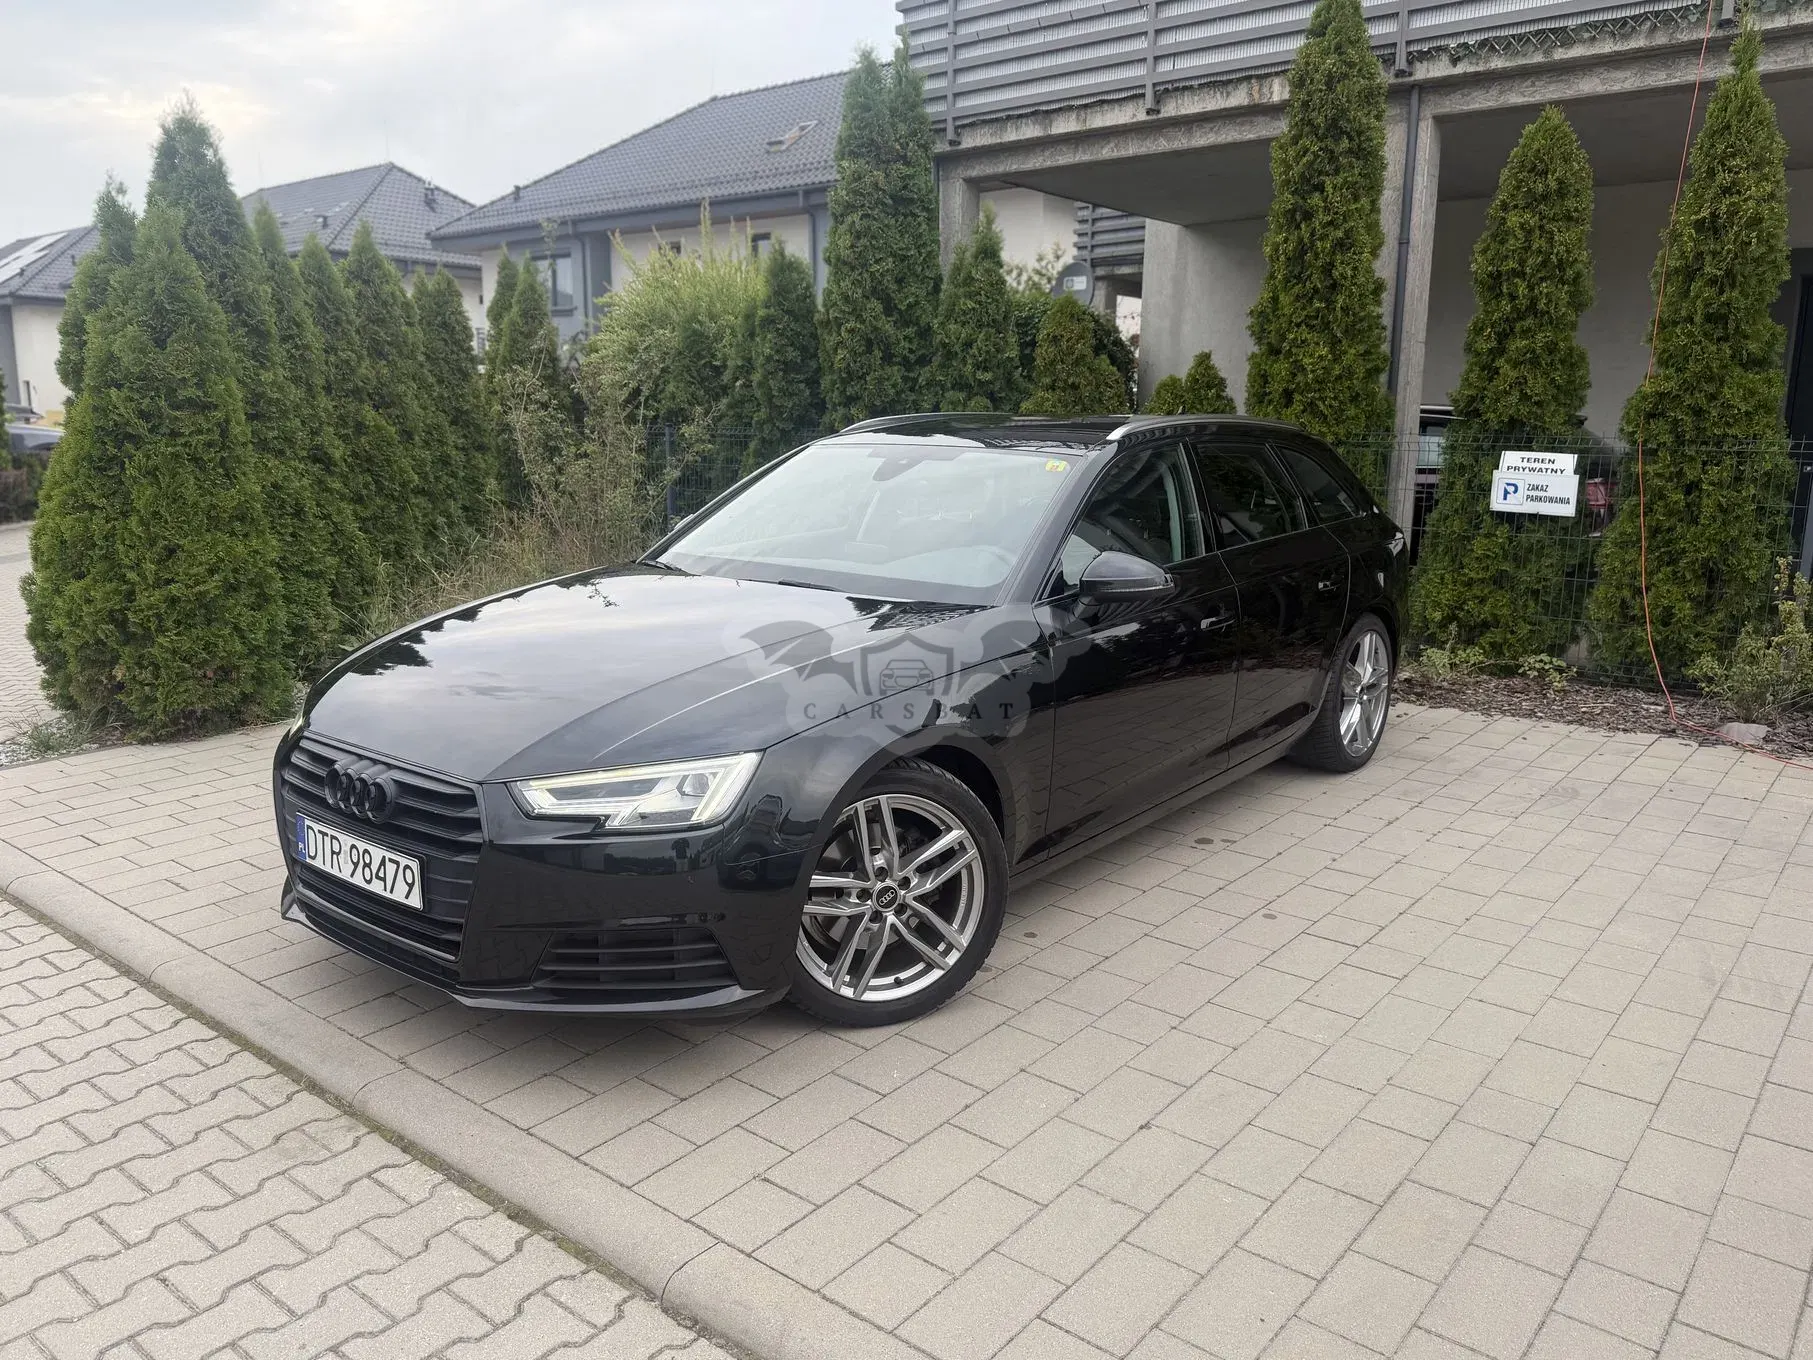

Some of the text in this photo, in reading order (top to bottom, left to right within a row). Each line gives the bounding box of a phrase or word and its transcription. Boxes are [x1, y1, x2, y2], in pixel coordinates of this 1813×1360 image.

[1507, 466, 1566, 475] PRYWATNY
[1526, 484, 1549, 492] ZAKAZ
[1526, 495, 1571, 505] PARKOWANIA
[306, 824, 416, 900] DTR 98479
